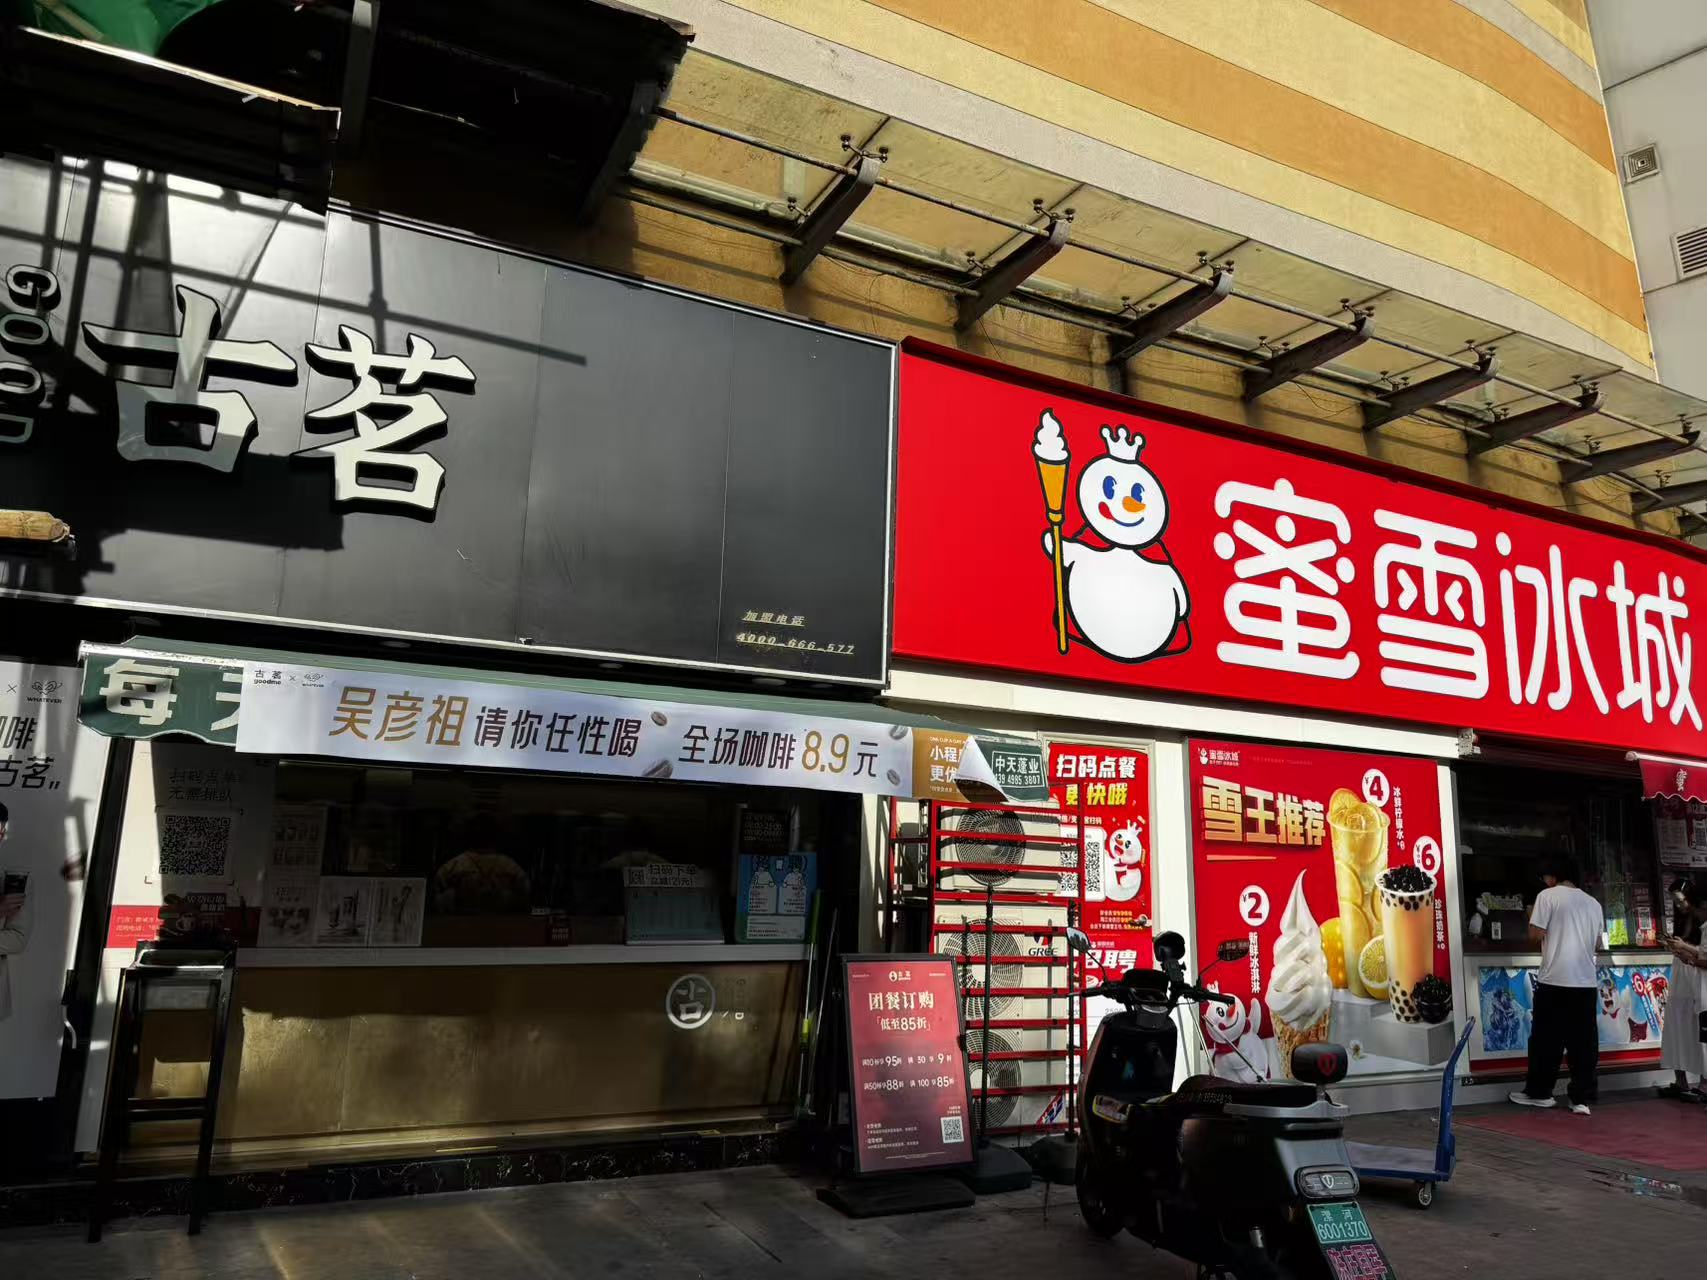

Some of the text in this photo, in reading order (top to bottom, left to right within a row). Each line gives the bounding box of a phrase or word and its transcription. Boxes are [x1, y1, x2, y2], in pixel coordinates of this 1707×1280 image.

[82, 285, 476, 515] 古茗
[1214, 477, 1702, 731] 蜜雪冰城
[743, 610, 805, 626] 加盟电话
[254, 669, 282, 679] 古茗
[995, 755, 1040, 774] 中天蓬业
[1056, 754, 1137, 779] 扫码点餐
[1202, 775, 1326, 847] 雪王推荐
[868, 990, 934, 1010] 团餐订购
[1317, 1221, 1368, 1240] 6001370
